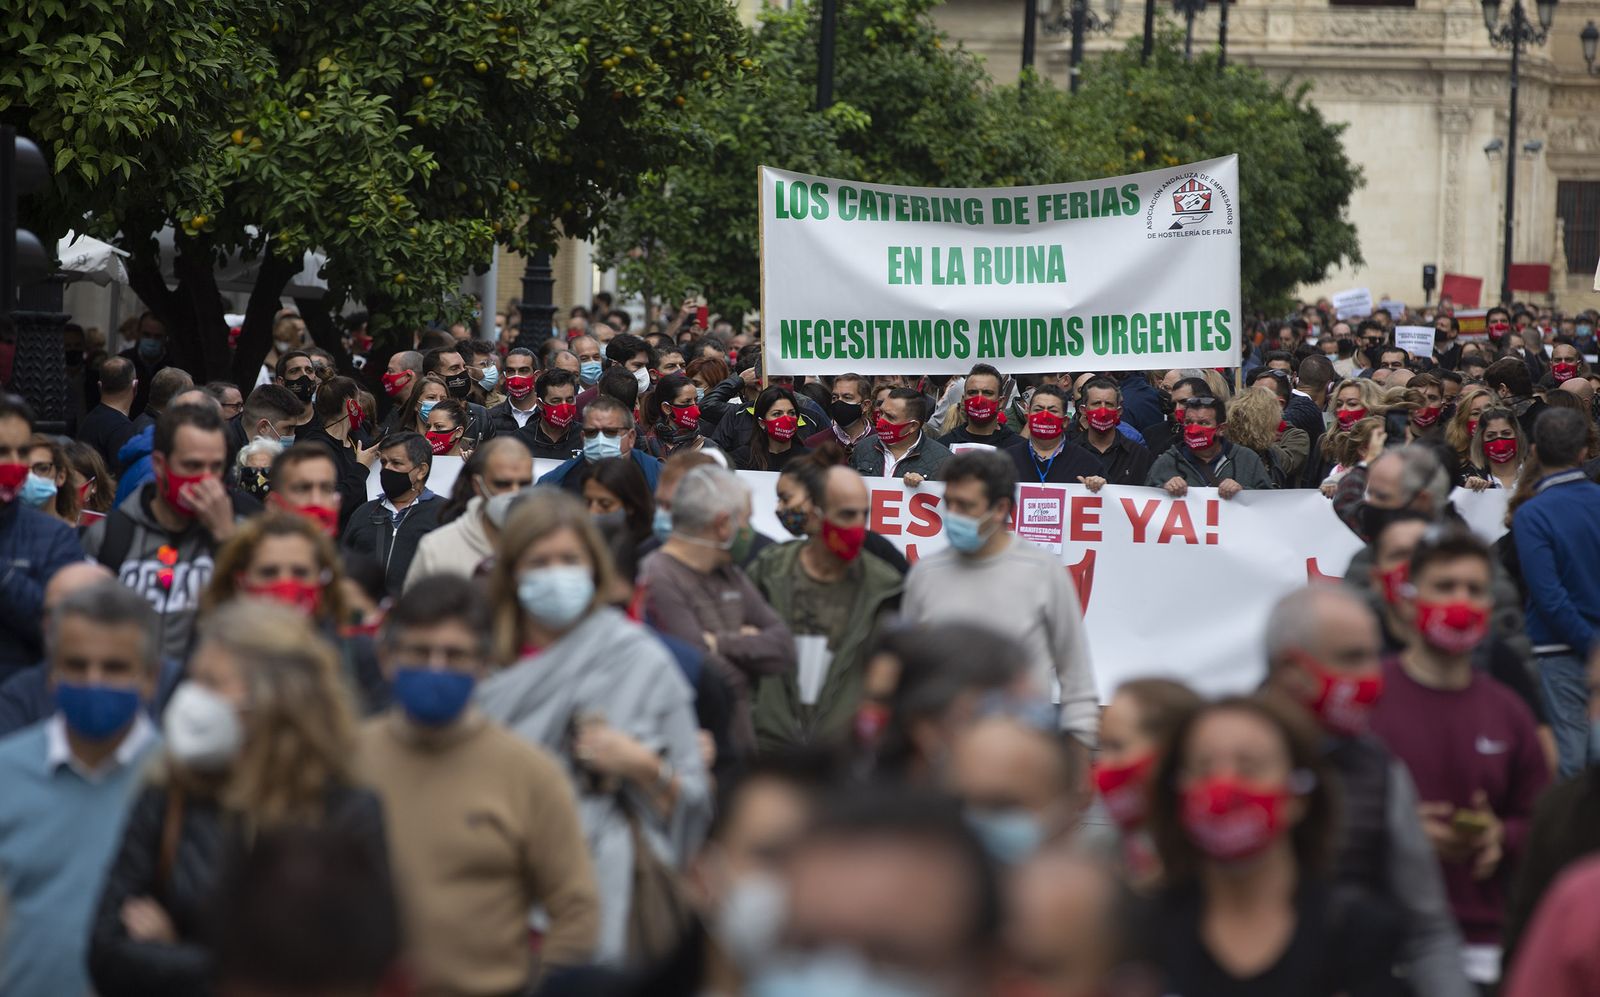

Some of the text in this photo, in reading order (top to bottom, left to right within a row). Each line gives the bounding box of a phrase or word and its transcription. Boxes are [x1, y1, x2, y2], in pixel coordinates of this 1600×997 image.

[774, 180, 1141, 225] LOS CATERING DE FERIAS
[1162, 172, 1198, 190] ANDALUZA
[1200, 173, 1209, 182] DE
[1210, 178, 1234, 225] EMPRESARIOS
[1158, 229, 1200, 239] HOSTELERÍA
[886, 245, 1066, 286] EN LA RUINA
[780, 309, 1232, 361] NECESITAMOS AYUDAS URGENTES
[1119, 498, 1219, 545] YA!
